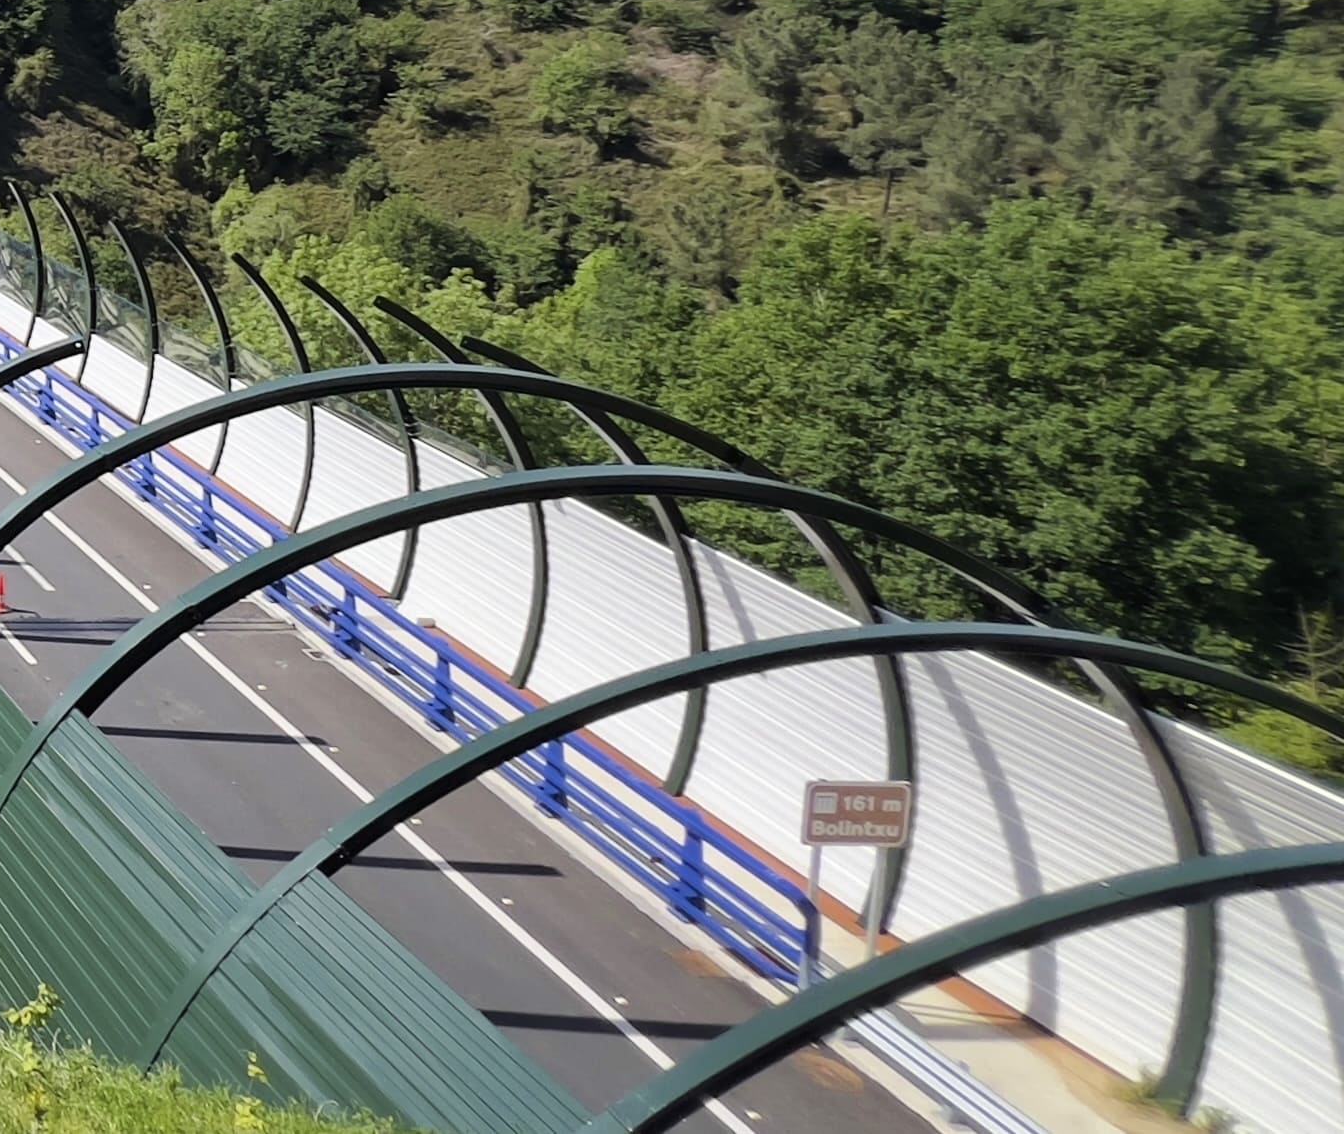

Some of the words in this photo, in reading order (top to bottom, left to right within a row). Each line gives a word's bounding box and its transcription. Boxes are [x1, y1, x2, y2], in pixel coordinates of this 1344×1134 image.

[843, 795, 875, 811] 161
[882, 800, 902, 812] m
[812, 820, 899, 837] Bolintxu
